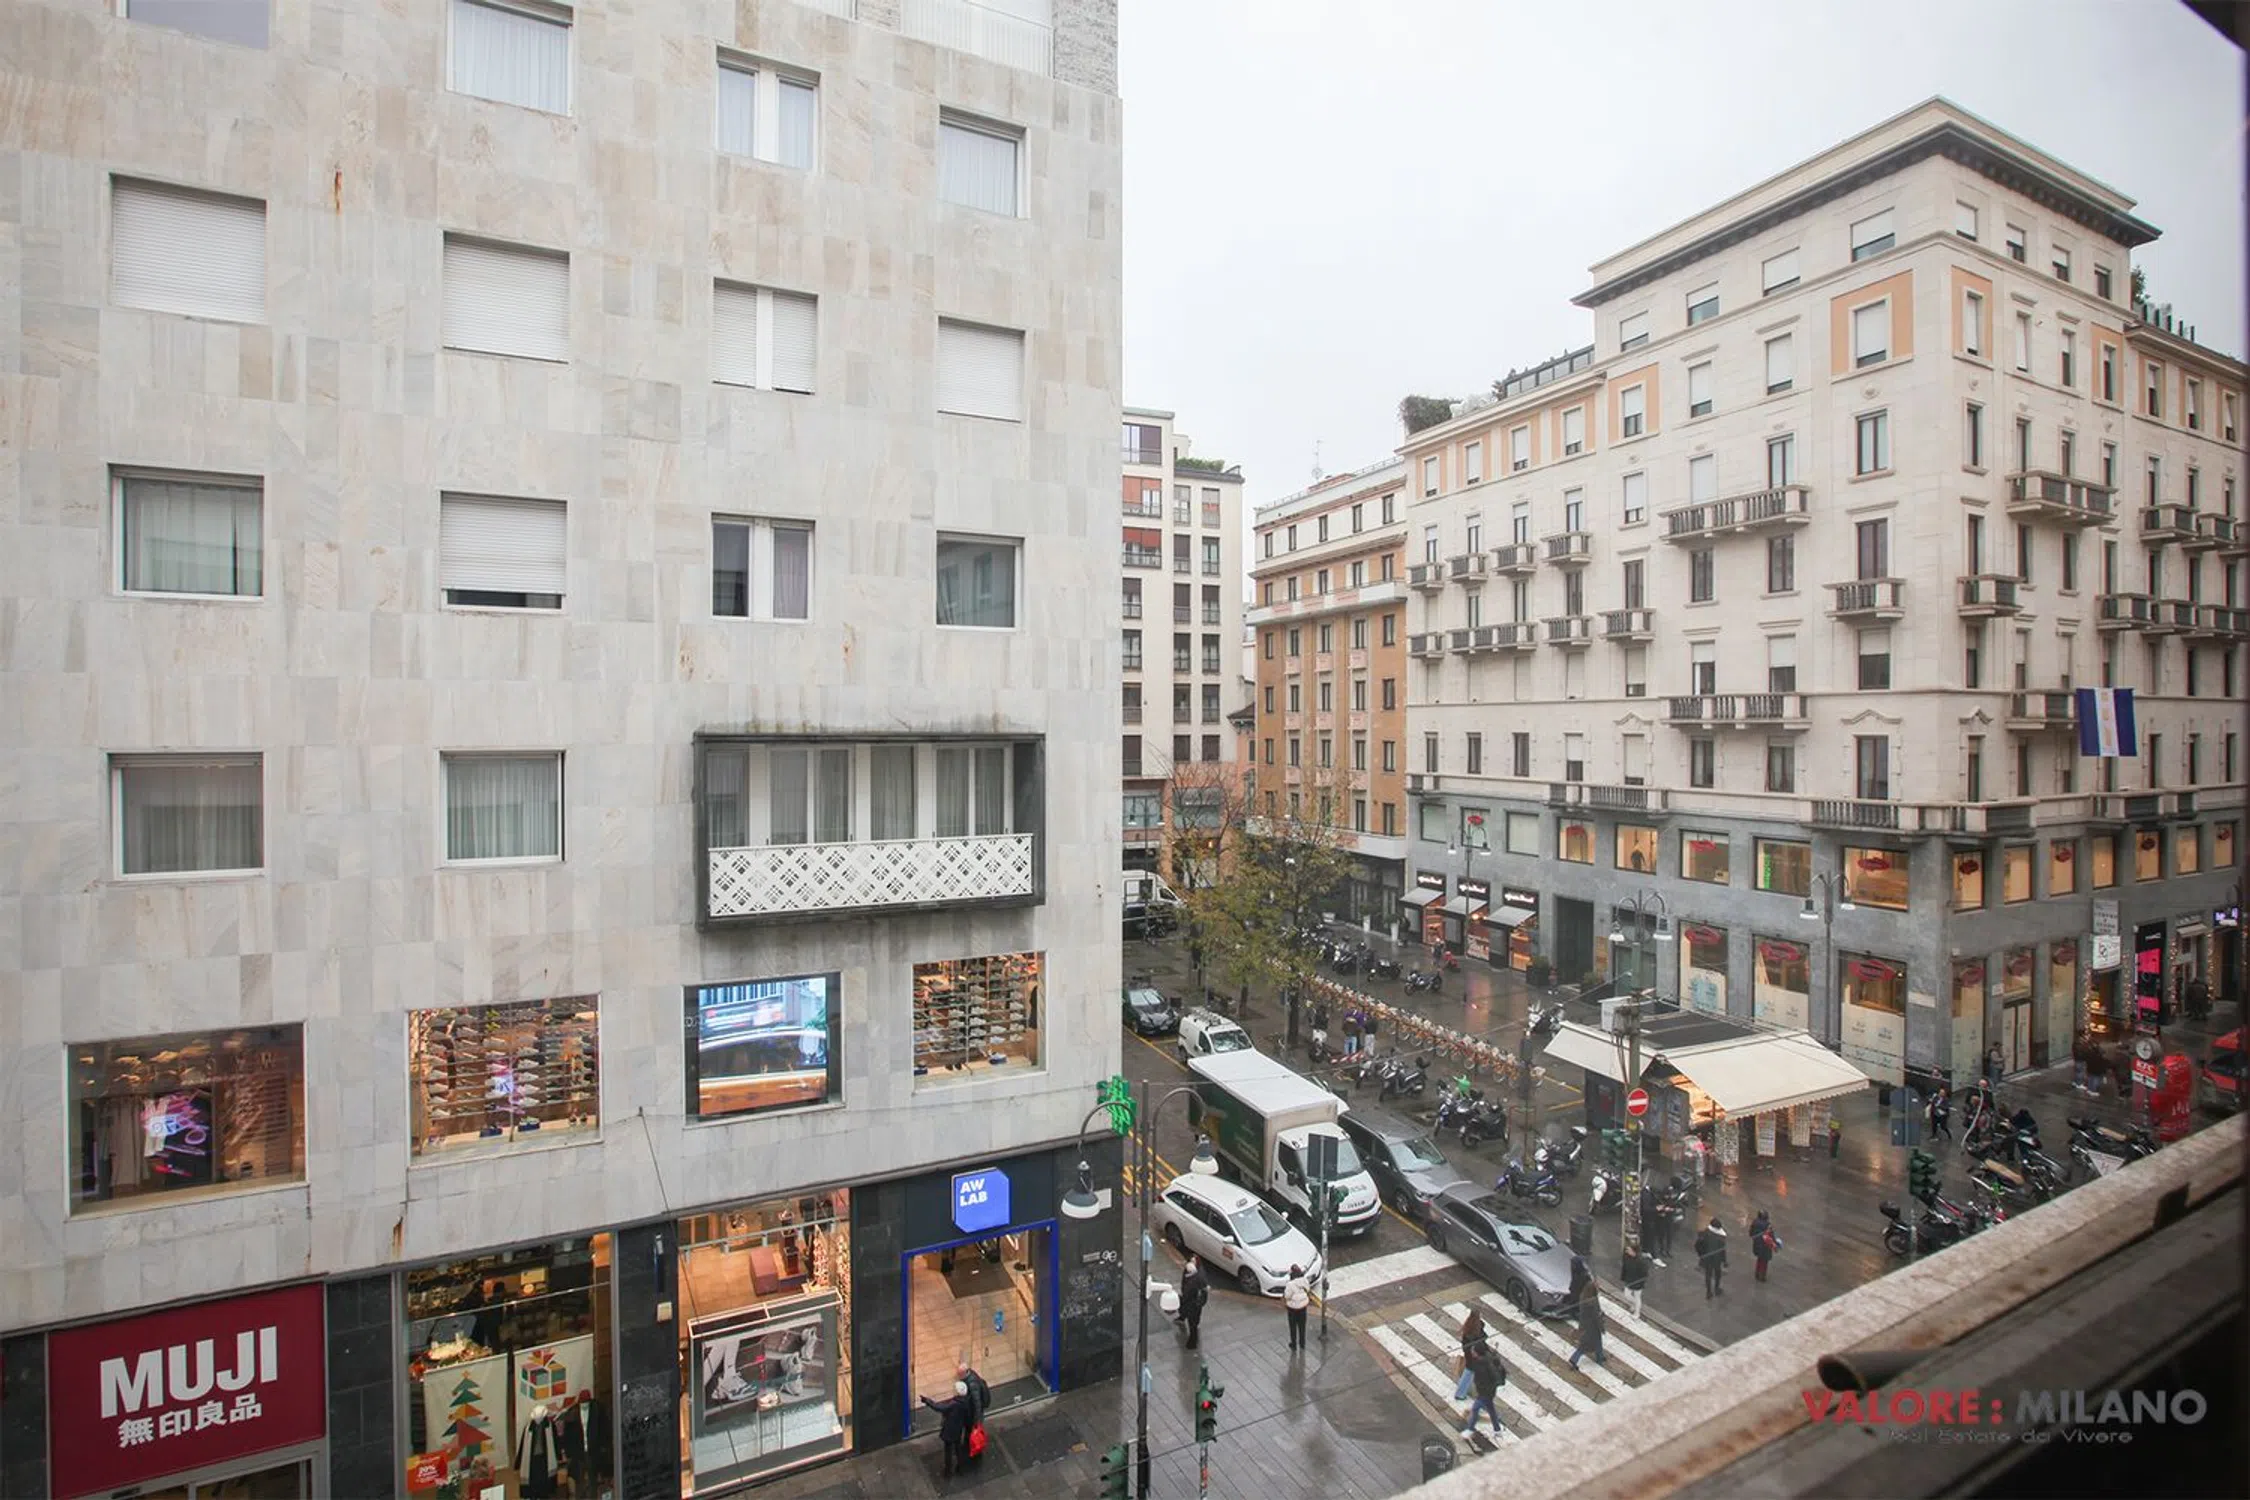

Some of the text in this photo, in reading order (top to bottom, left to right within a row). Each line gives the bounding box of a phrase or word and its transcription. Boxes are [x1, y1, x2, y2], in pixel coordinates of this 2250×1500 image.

[960, 1177, 986, 1194] AW
[960, 1190, 988, 1207] LAB
[100, 1325, 278, 1419] MUJI
[118, 1393, 263, 1448] 無印良品
